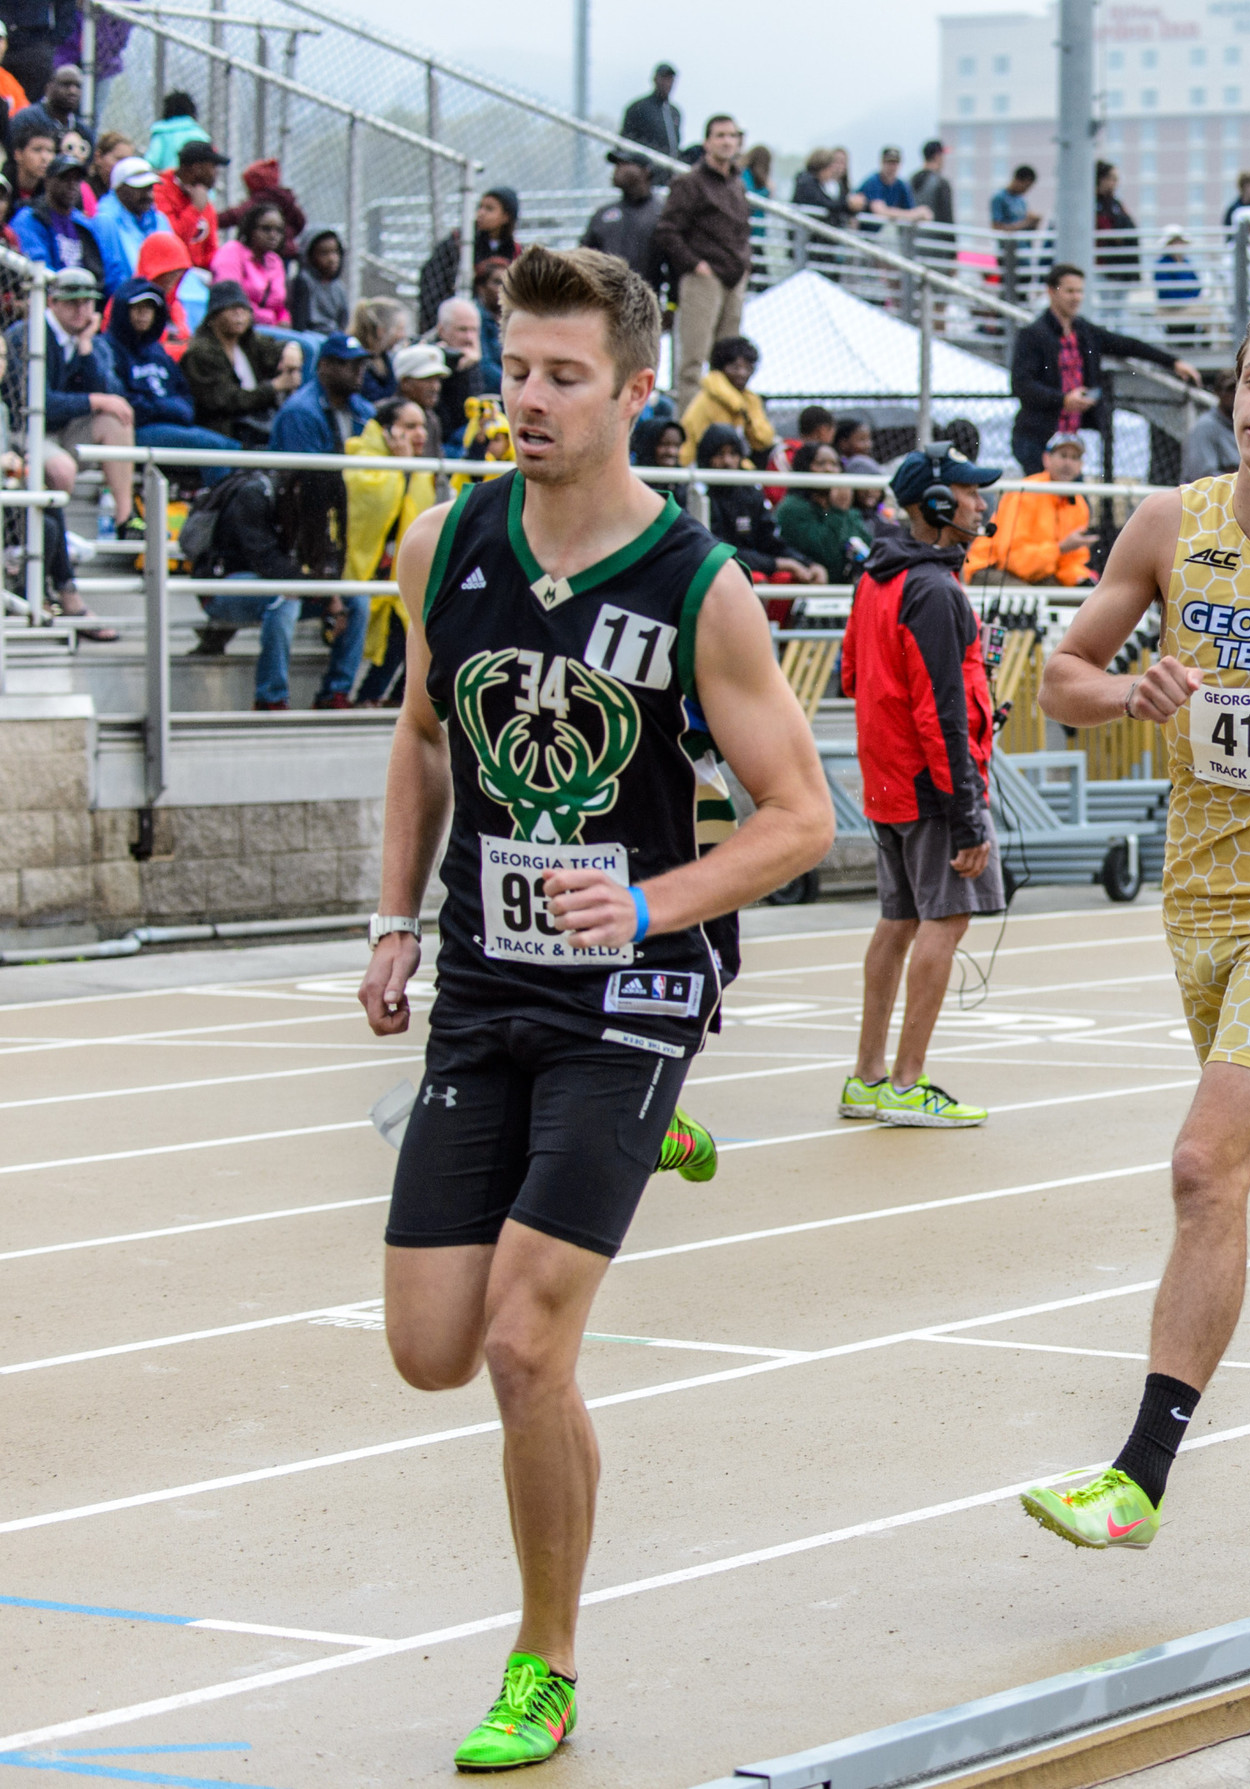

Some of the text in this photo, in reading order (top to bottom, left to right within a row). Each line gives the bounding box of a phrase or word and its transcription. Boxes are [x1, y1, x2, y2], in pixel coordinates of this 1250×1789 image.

[1187, 548, 1241, 569] ACC
[600, 613, 662, 684] 11
[515, 649, 570, 719] 34
[1209, 760, 1247, 781] TRACK
[489, 850, 564, 870] GEORGIA
[496, 936, 545, 956] TRACK
[552, 944, 565, 956] &
